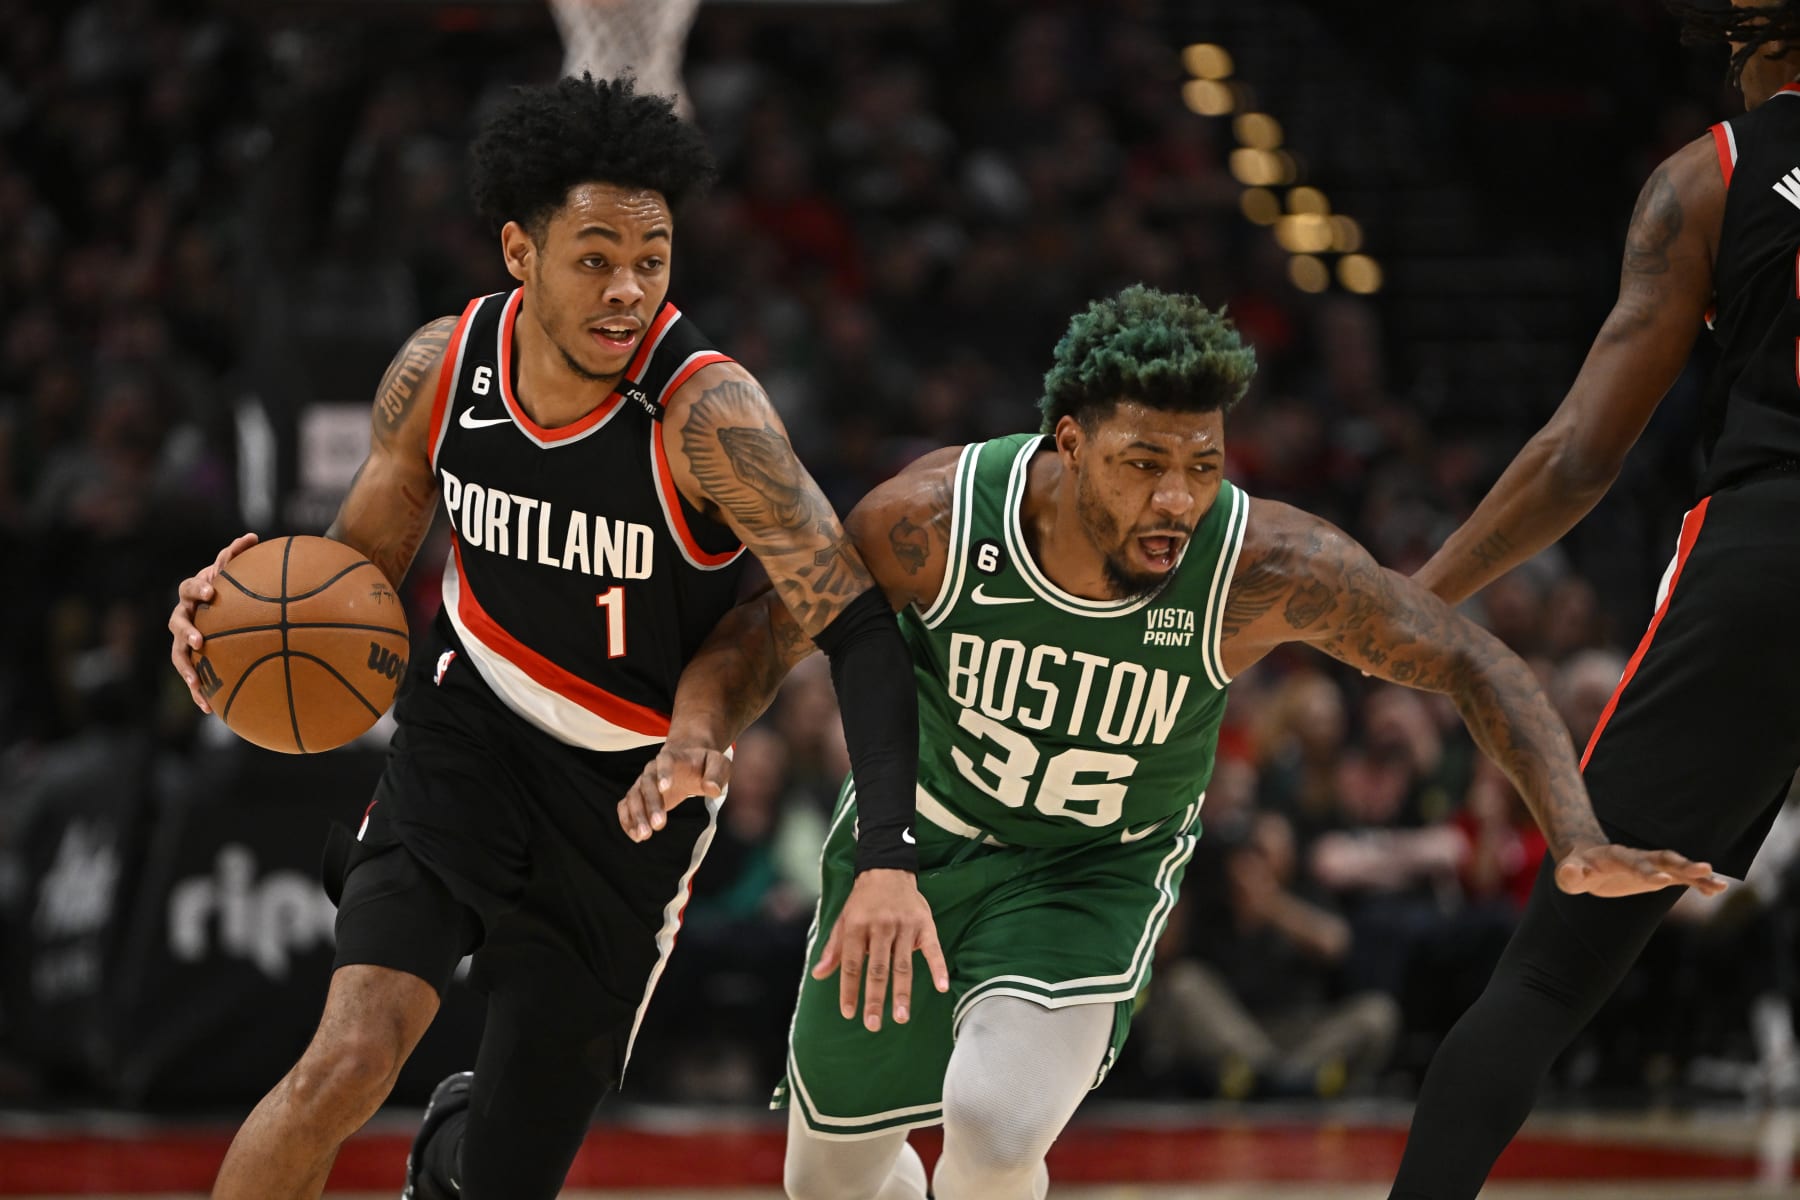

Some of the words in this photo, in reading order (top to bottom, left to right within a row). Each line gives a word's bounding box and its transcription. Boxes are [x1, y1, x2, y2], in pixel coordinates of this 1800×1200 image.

[472, 366, 492, 395] 6
[440, 467, 654, 580] PORTLAND
[977, 543, 999, 572] 6
[596, 586, 627, 659] 1
[1143, 631, 1194, 646] PRINT
[1146, 608, 1194, 631] VISTA
[948, 632, 1190, 745] BOSTON
[951, 708, 1139, 827] 36
